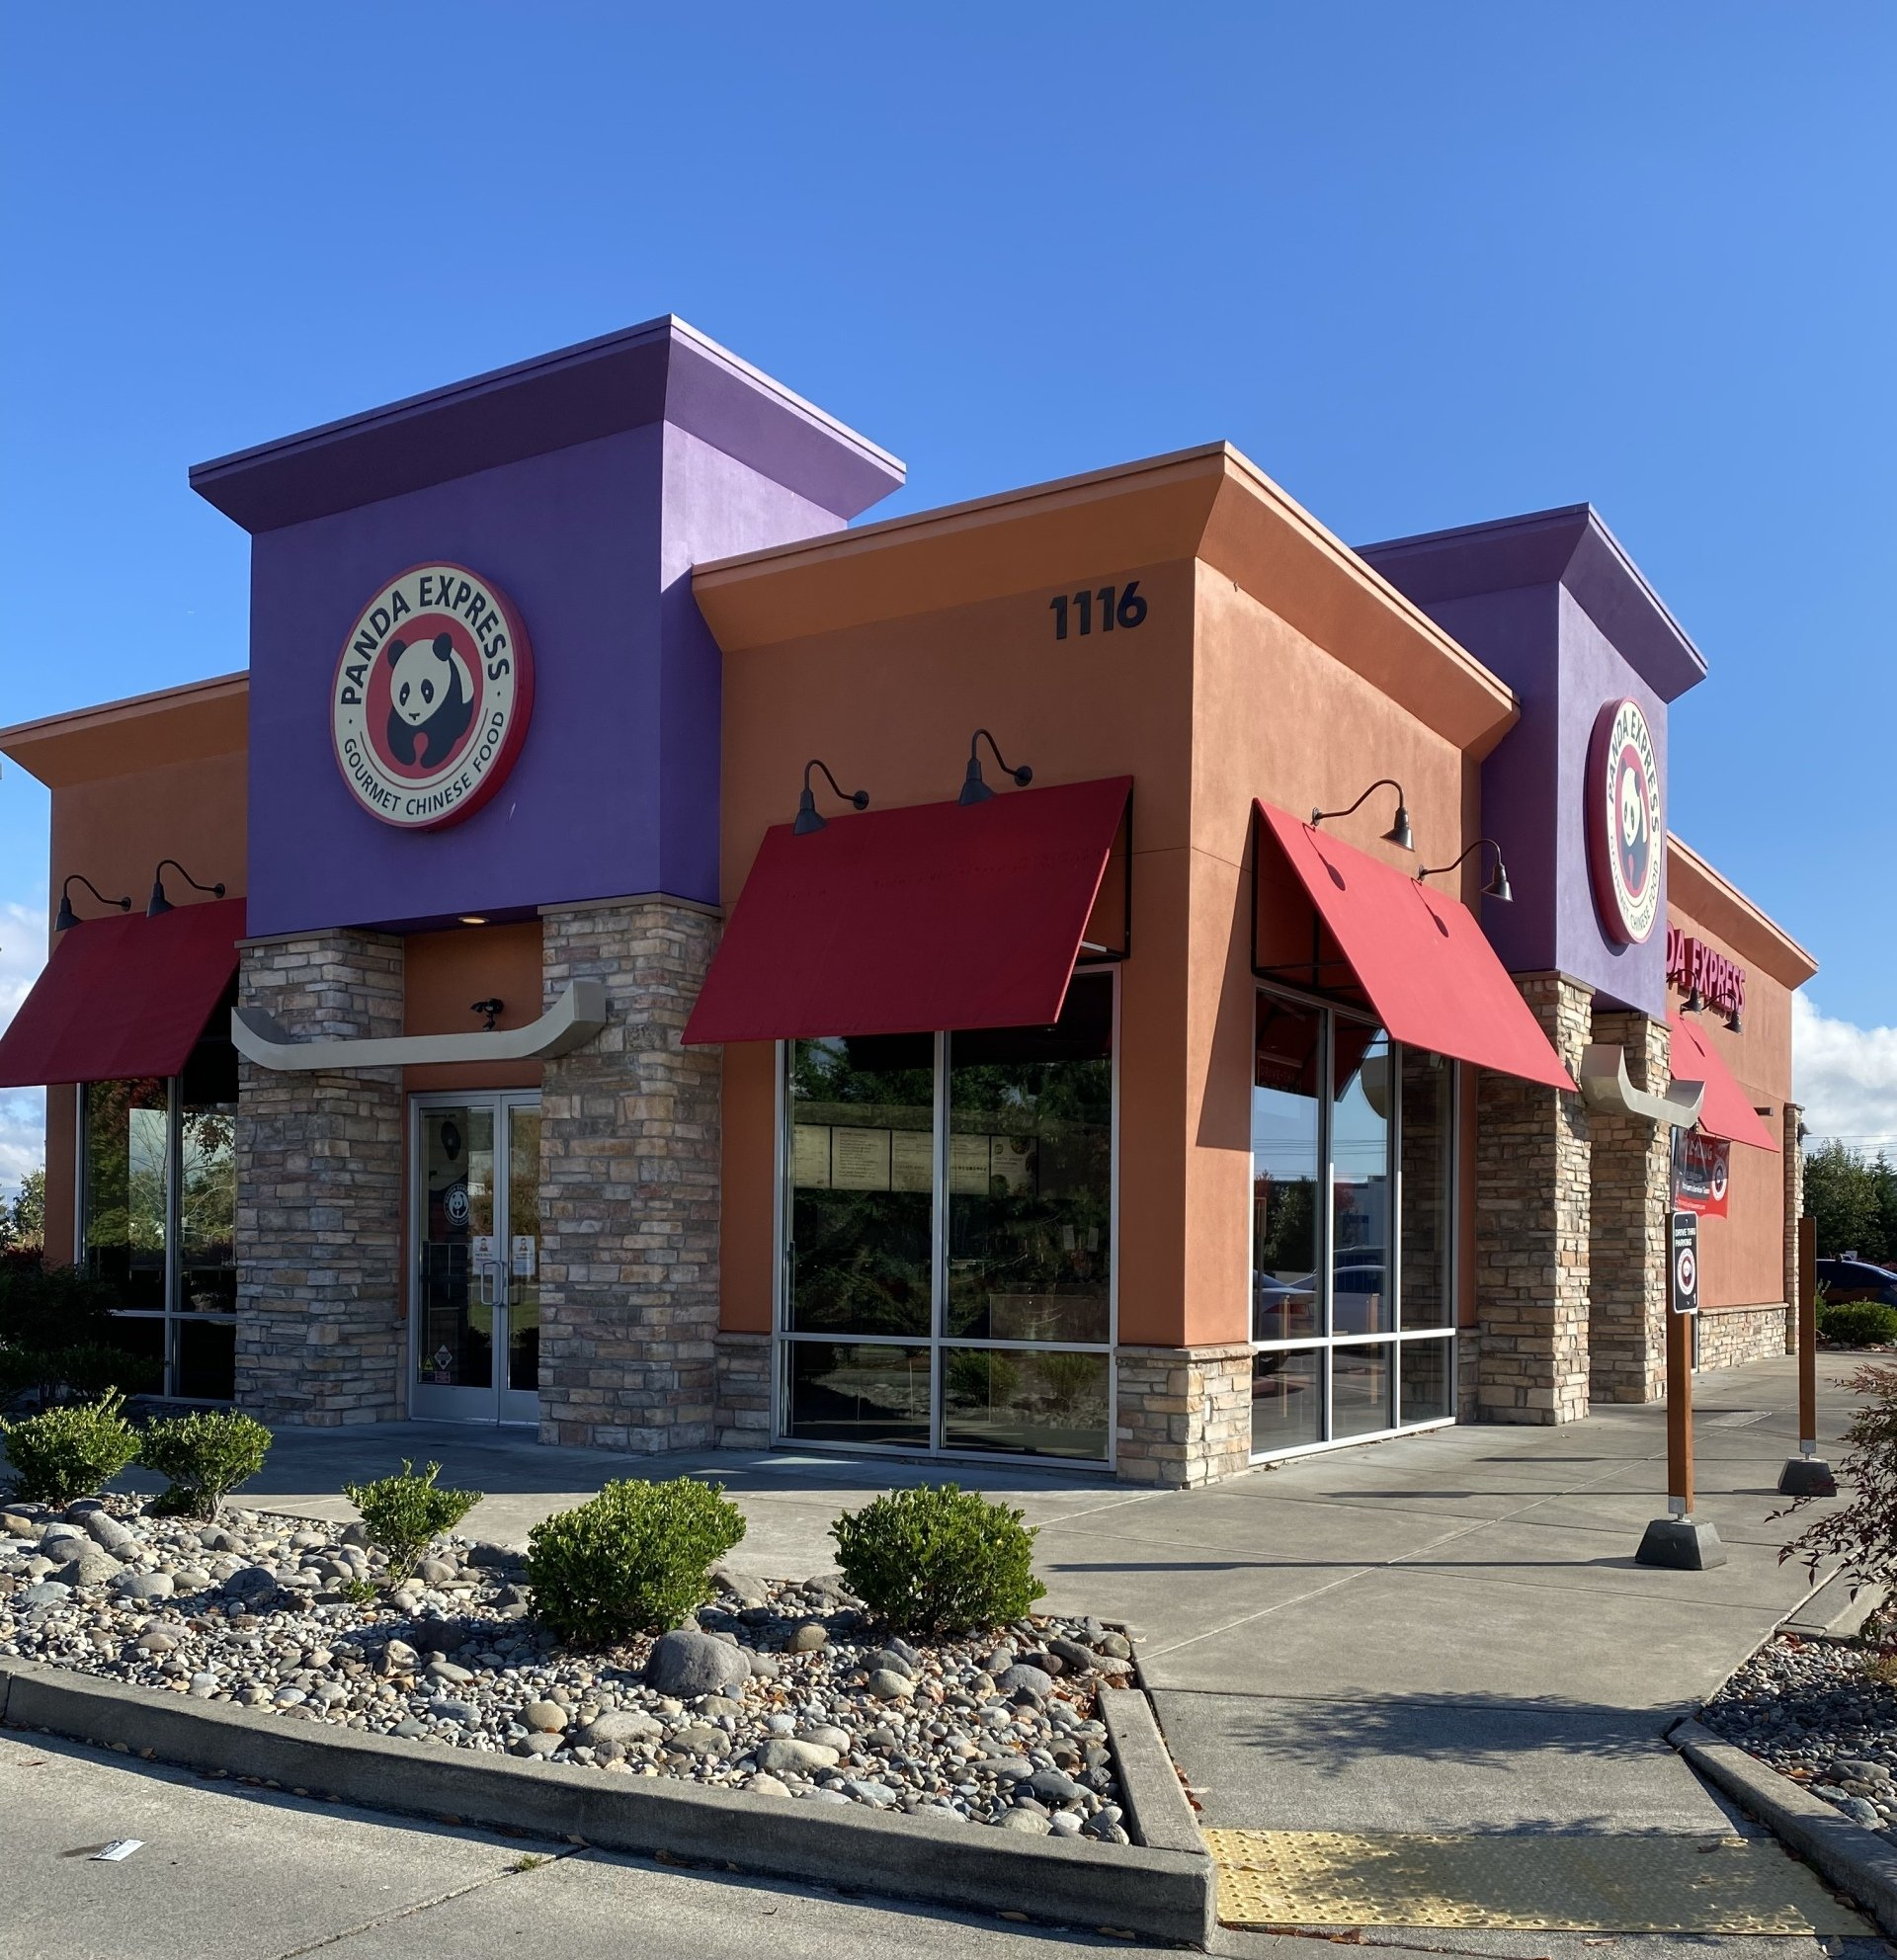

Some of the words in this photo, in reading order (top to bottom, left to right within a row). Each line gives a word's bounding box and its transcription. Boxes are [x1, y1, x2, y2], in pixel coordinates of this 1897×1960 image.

[340, 589, 412, 705] PANDA
[419, 574, 510, 682] EXPRESS
[1049, 581, 1148, 640] 1116
[344, 738, 402, 813] GOURMET
[405, 772, 472, 816] CHINESE
[473, 710, 505, 774] FOOD
[1608, 709, 1629, 804] PANDA
[1630, 709, 1660, 833] EXPRESS
[1648, 859, 1659, 908] FOOD
[1691, 937, 1746, 1015] EXPRESS
